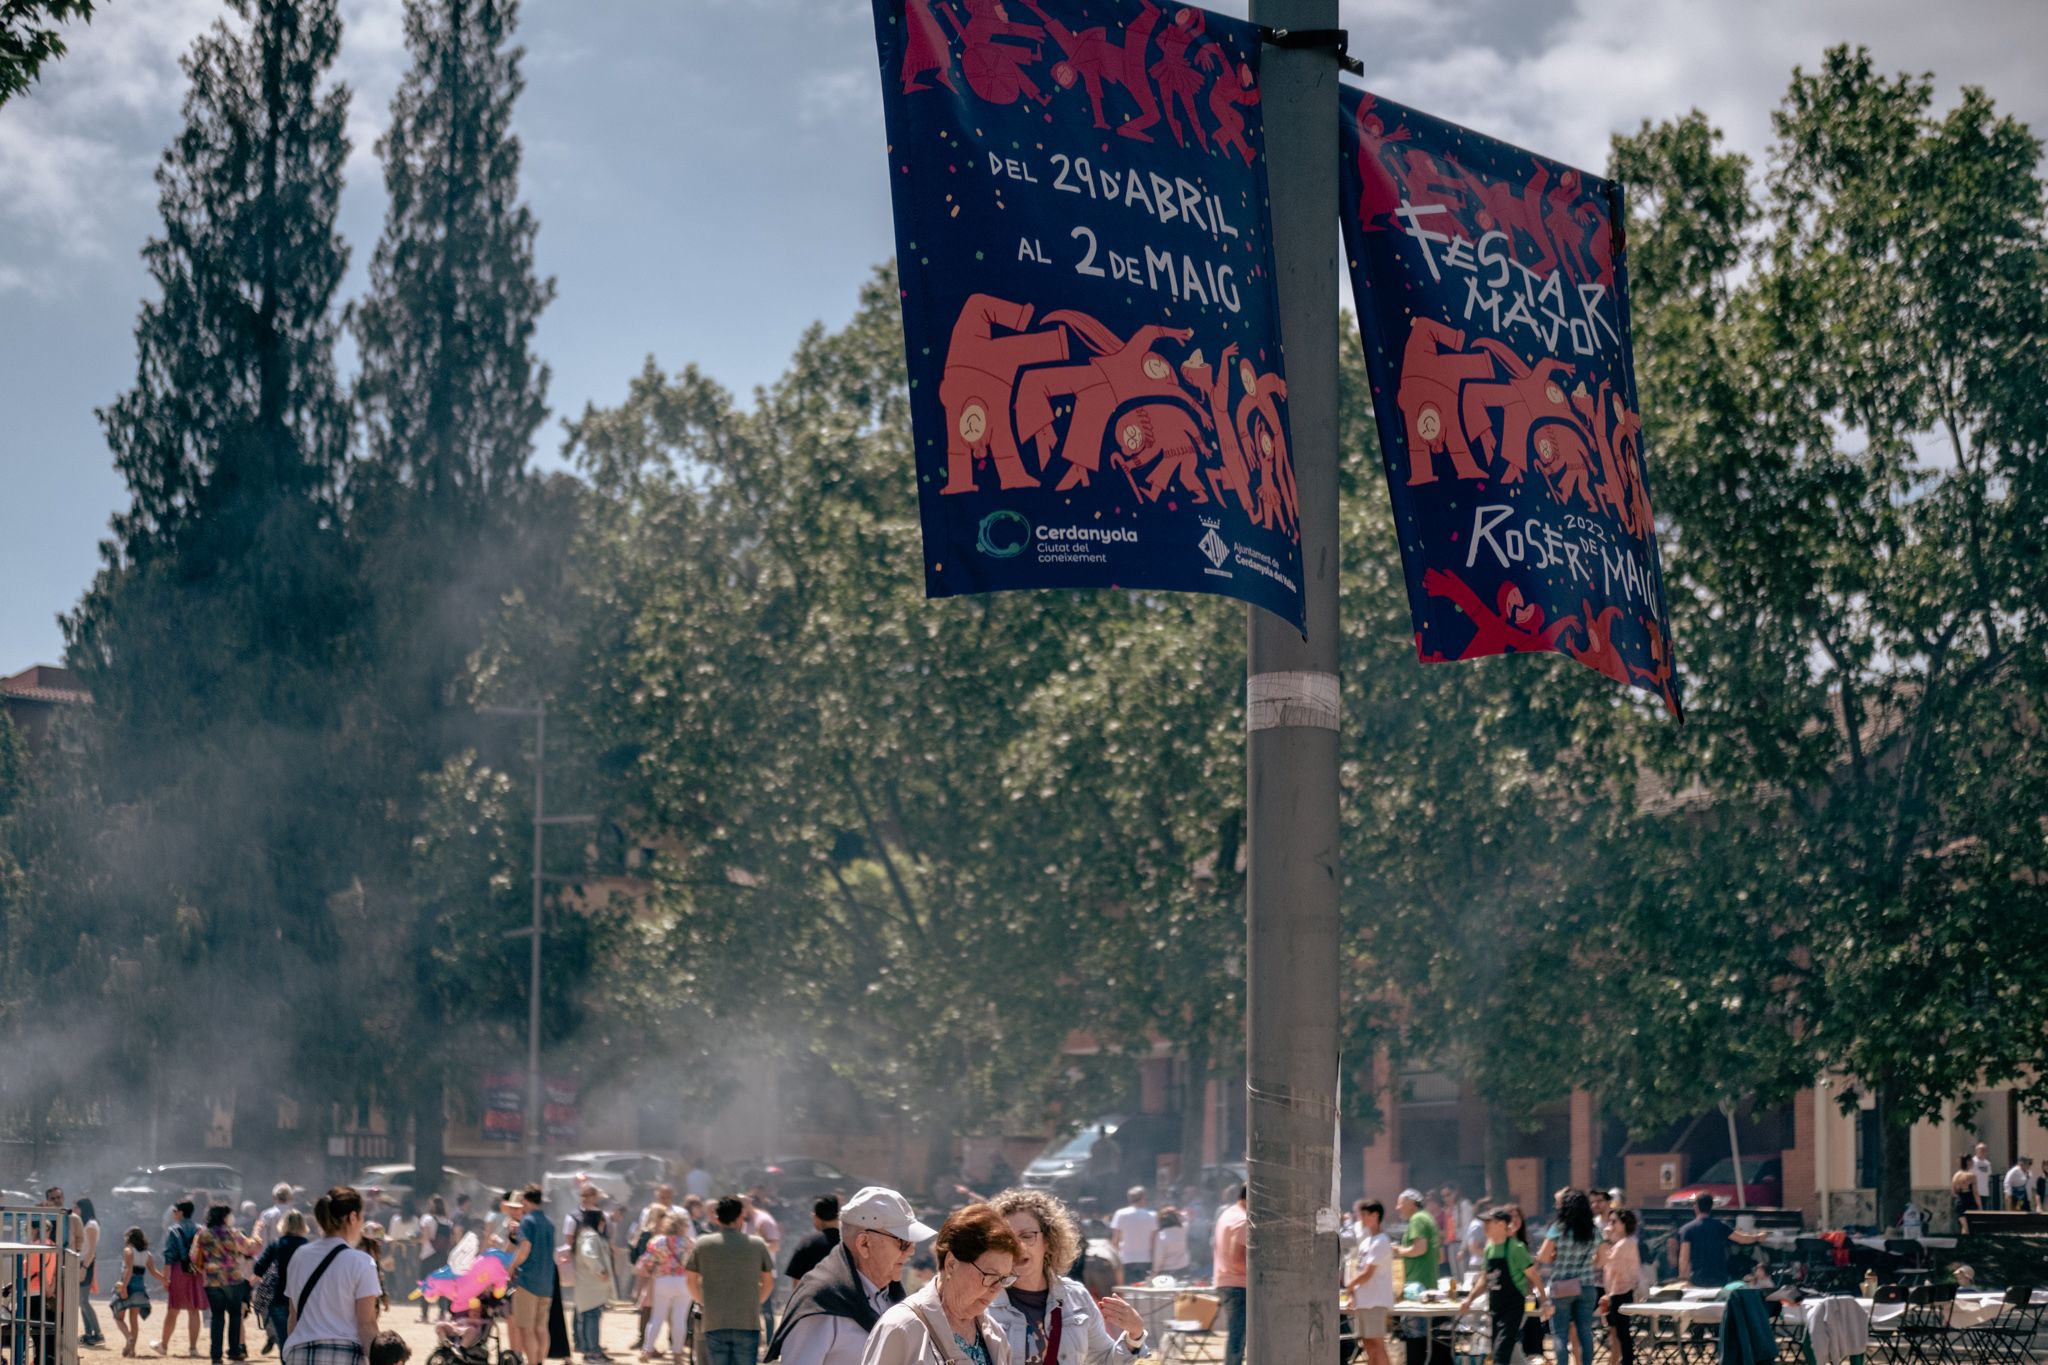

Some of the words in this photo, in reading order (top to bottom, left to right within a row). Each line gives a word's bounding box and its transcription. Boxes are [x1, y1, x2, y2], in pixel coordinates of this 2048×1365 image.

[989, 151, 1038, 183] DEL
[1050, 154, 1096, 199] 29
[1099, 168, 1239, 238] D'ABRIL
[1018, 237, 1052, 265] AL
[1070, 226, 1105, 277] 2
[1109, 250, 1144, 285] DE
[1144, 245, 1241, 313] MAIG
[1395, 199, 1565, 317] FESTA
[1463, 283, 1619, 355] MAJOR
[1035, 525, 1138, 544] Cerdanyola
[1466, 505, 1590, 581] ROSER
[1579, 536, 1599, 555] DE
[1564, 514, 1608, 543] 2022
[1037, 543, 1069, 553] Ciutat
[1072, 543, 1090, 553] del
[1038, 553, 1107, 563] coneixement
[1234, 541, 1272, 566] Ajuntament
[1272, 557, 1280, 570] de
[1235, 554, 1273, 577] Cerdanyola
